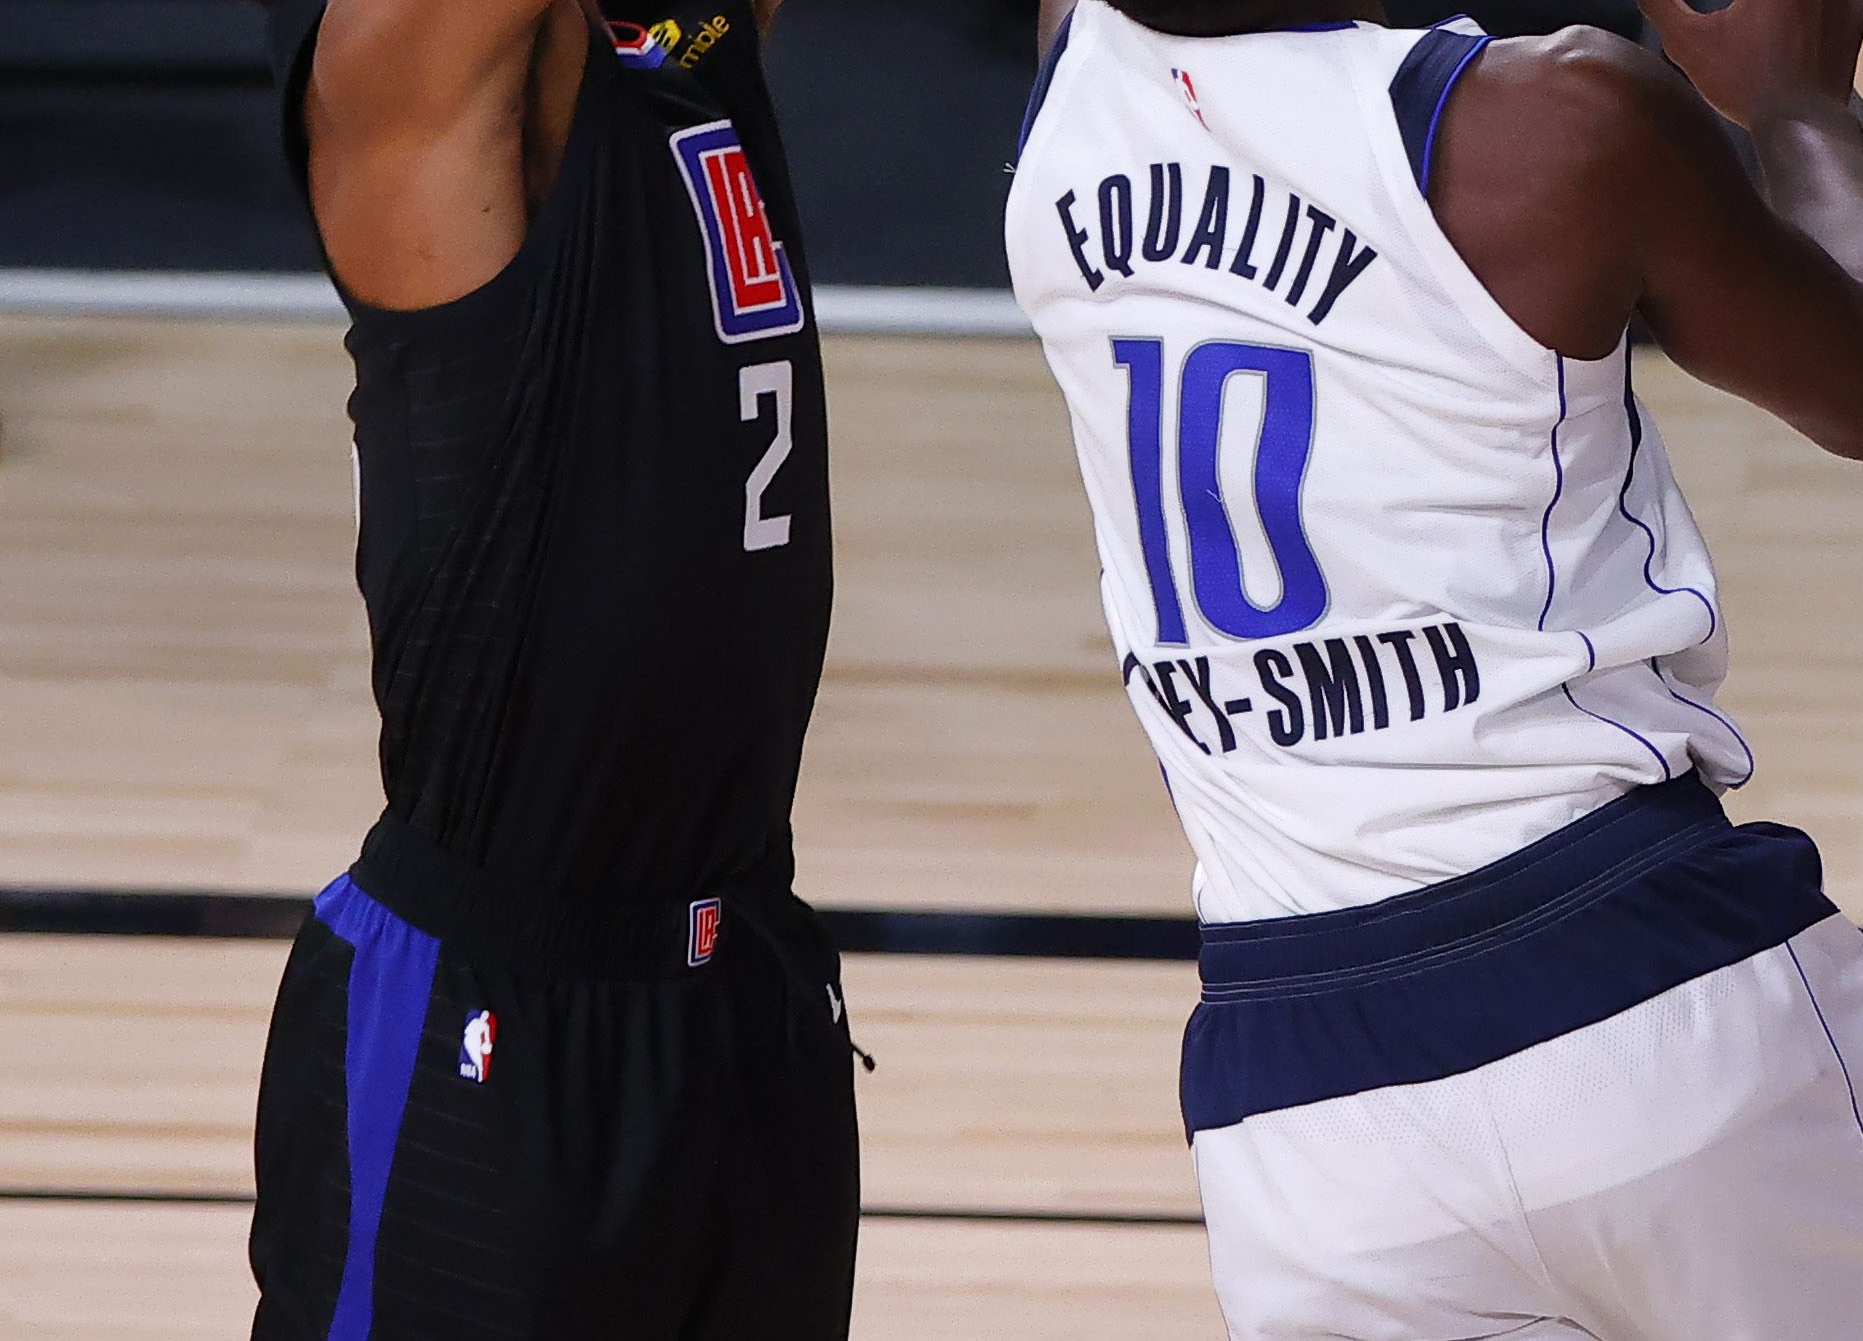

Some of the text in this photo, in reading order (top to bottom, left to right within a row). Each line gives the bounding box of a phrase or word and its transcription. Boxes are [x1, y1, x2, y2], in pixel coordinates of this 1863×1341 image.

[1056, 162, 1378, 326] EQUALITY
[739, 360, 793, 552] 2
[1108, 335, 1332, 649] 10
[1123, 621, 1481, 757] EY-SMITH
